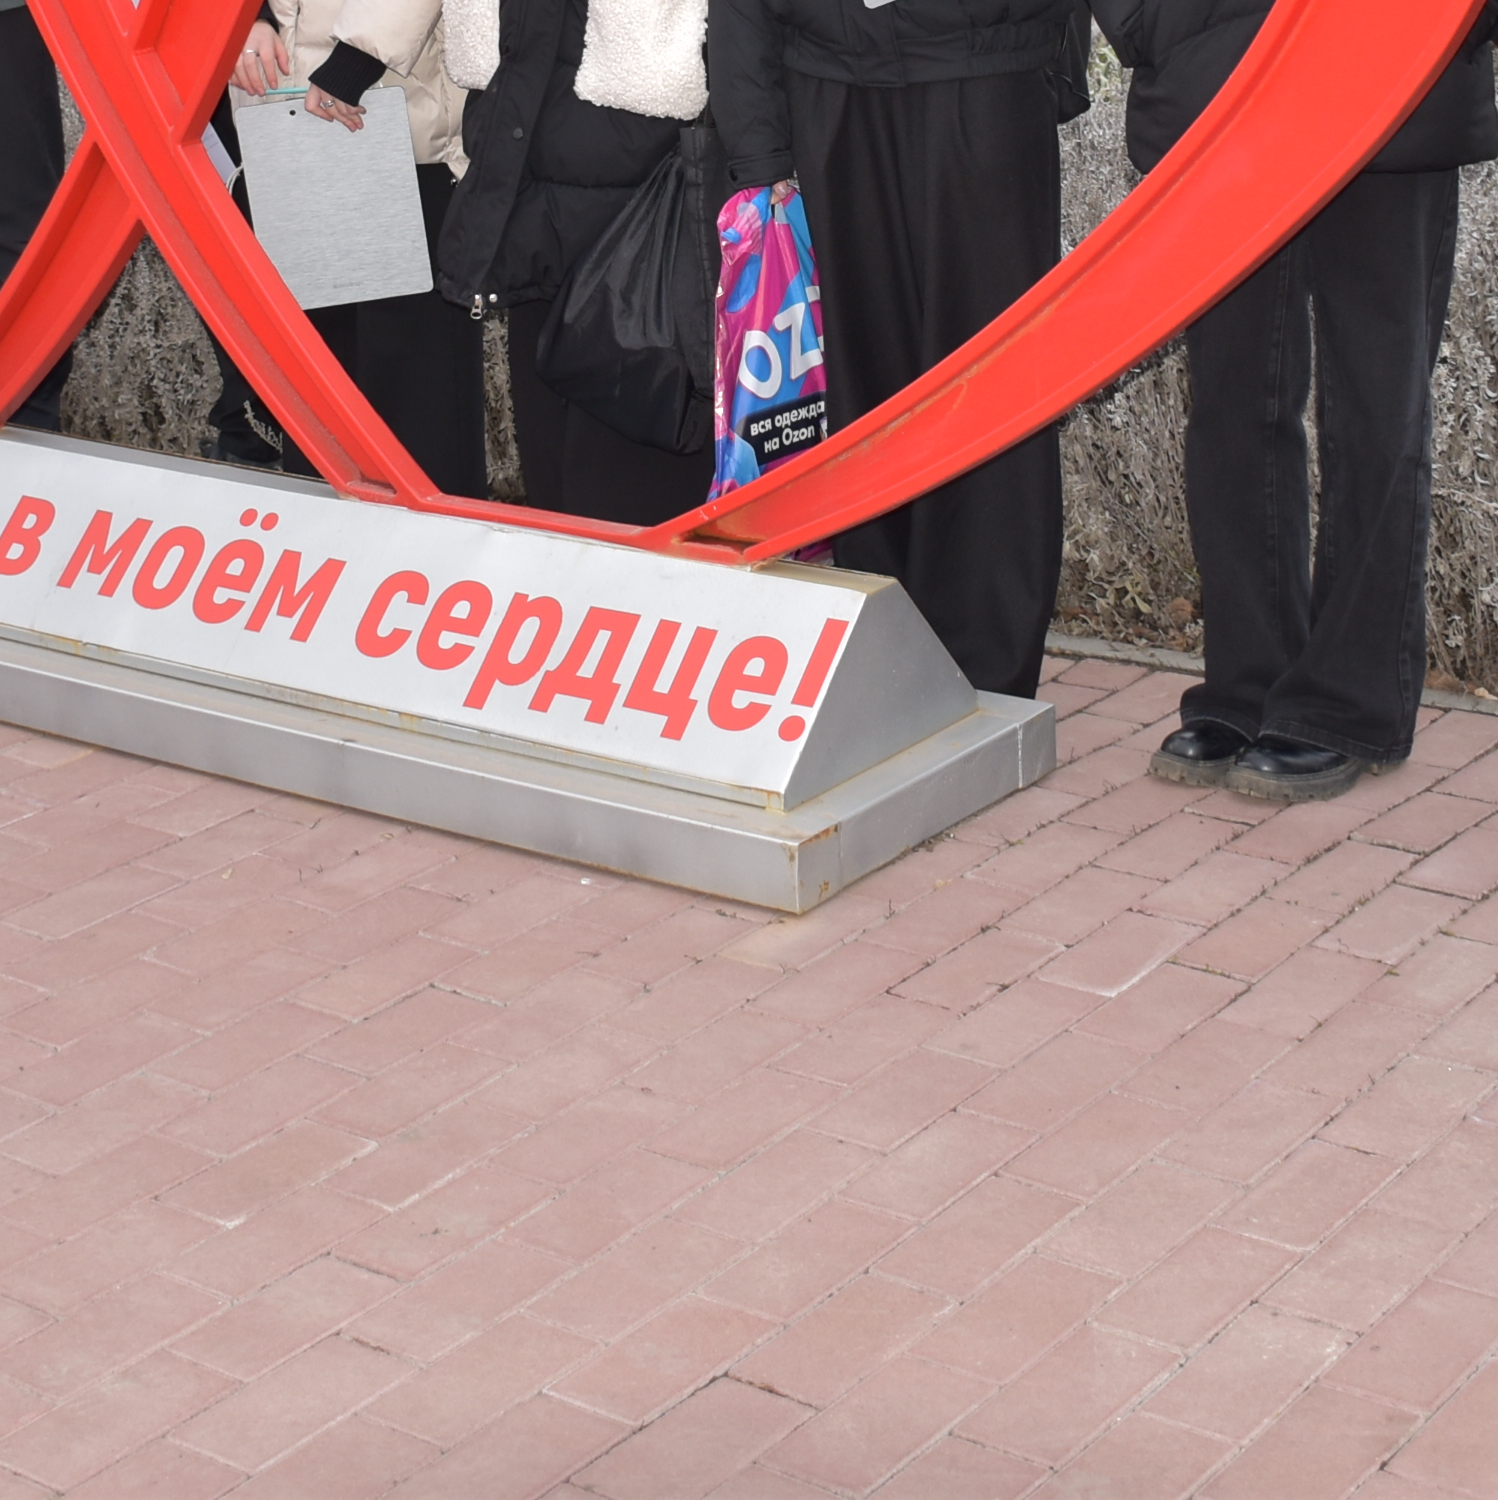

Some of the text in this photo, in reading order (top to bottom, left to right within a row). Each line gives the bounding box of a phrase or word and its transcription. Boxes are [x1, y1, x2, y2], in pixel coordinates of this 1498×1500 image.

[750, 401, 825, 436] вся одежда
[764, 415, 816, 454] на Ozon
[58, 509, 345, 642] моём
[356, 571, 848, 741] сердце!
